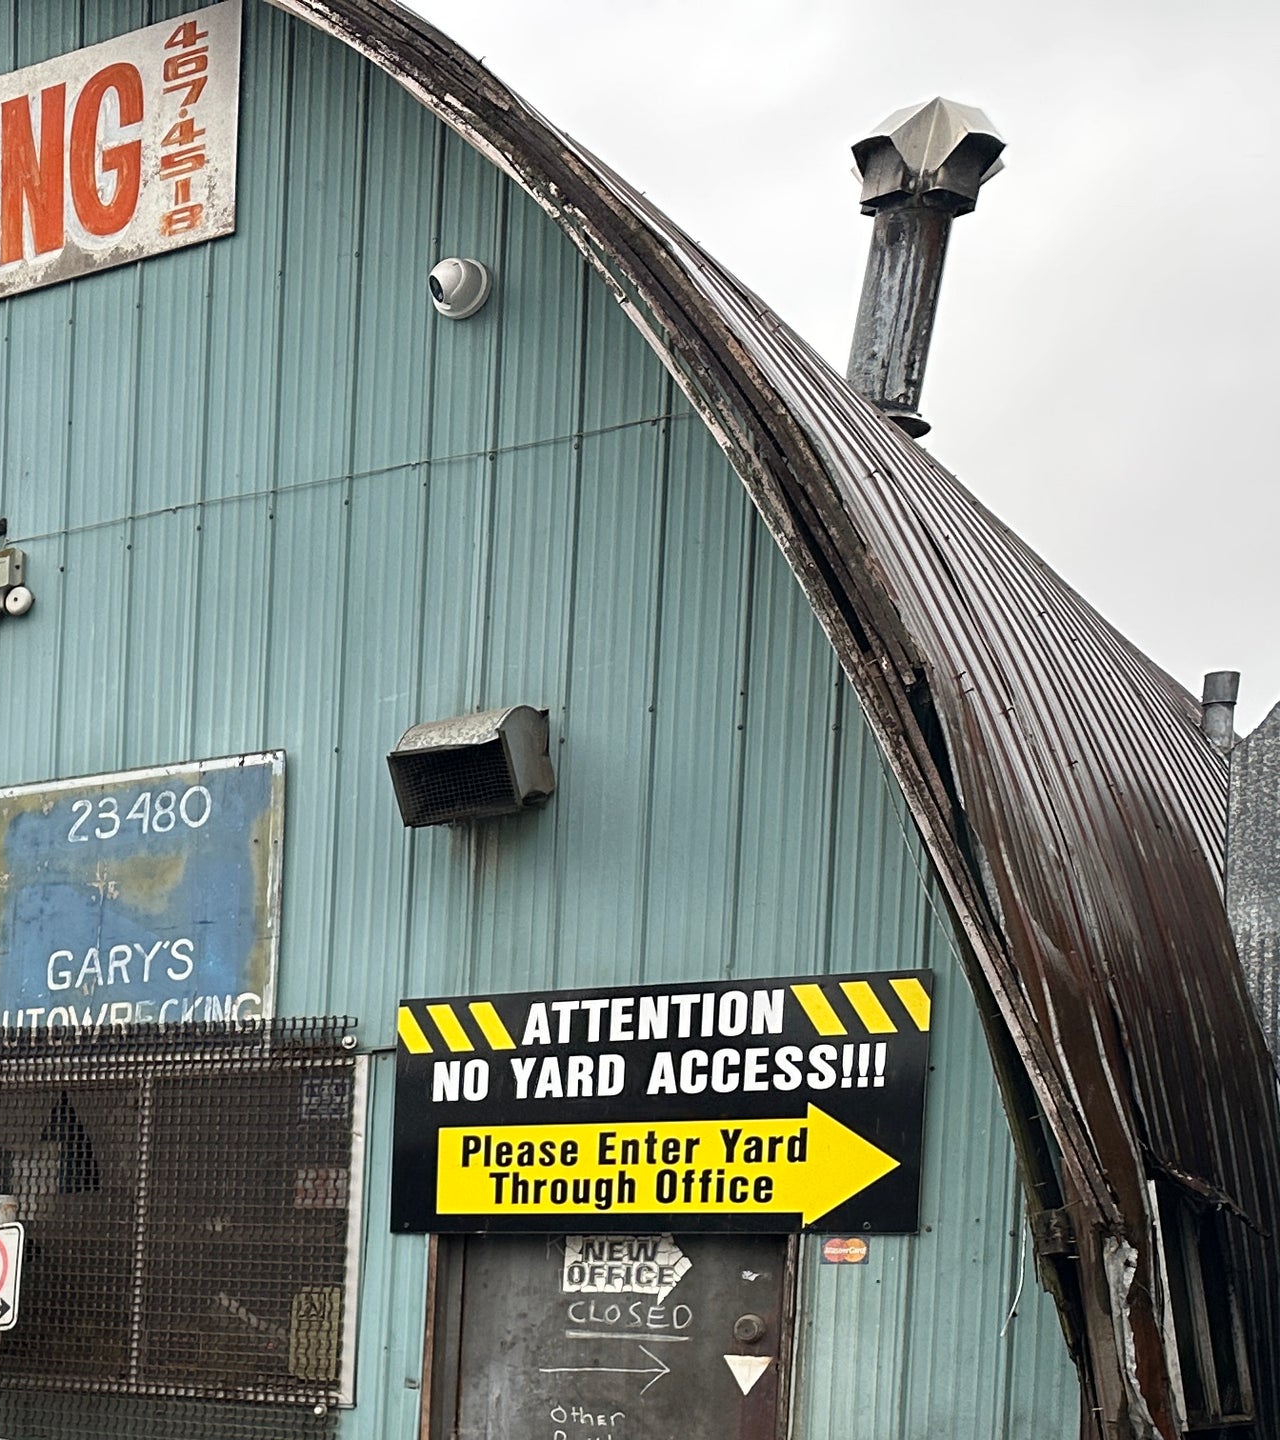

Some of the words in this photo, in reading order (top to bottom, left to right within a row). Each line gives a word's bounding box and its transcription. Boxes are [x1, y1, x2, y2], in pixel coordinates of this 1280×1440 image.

[67, 784, 213, 844] 23480
[46, 938, 196, 992] GARY'S
[521, 989, 785, 1046] ATTENTION
[432, 1058, 489, 1103] NO
[510, 1049, 626, 1099] YARD
[646, 1042, 888, 1096] ACCESS!!!
[461, 1134, 580, 1169] Please
[597, 1130, 701, 1166] Enter
[719, 1126, 809, 1164] Yard
[489, 1170, 637, 1210] Through
[655, 1167, 775, 1204] Office
[583, 1239, 659, 1262] NEW
[567, 1263, 675, 1288] OFFICE
[568, 1300, 693, 1330] CLOSED
